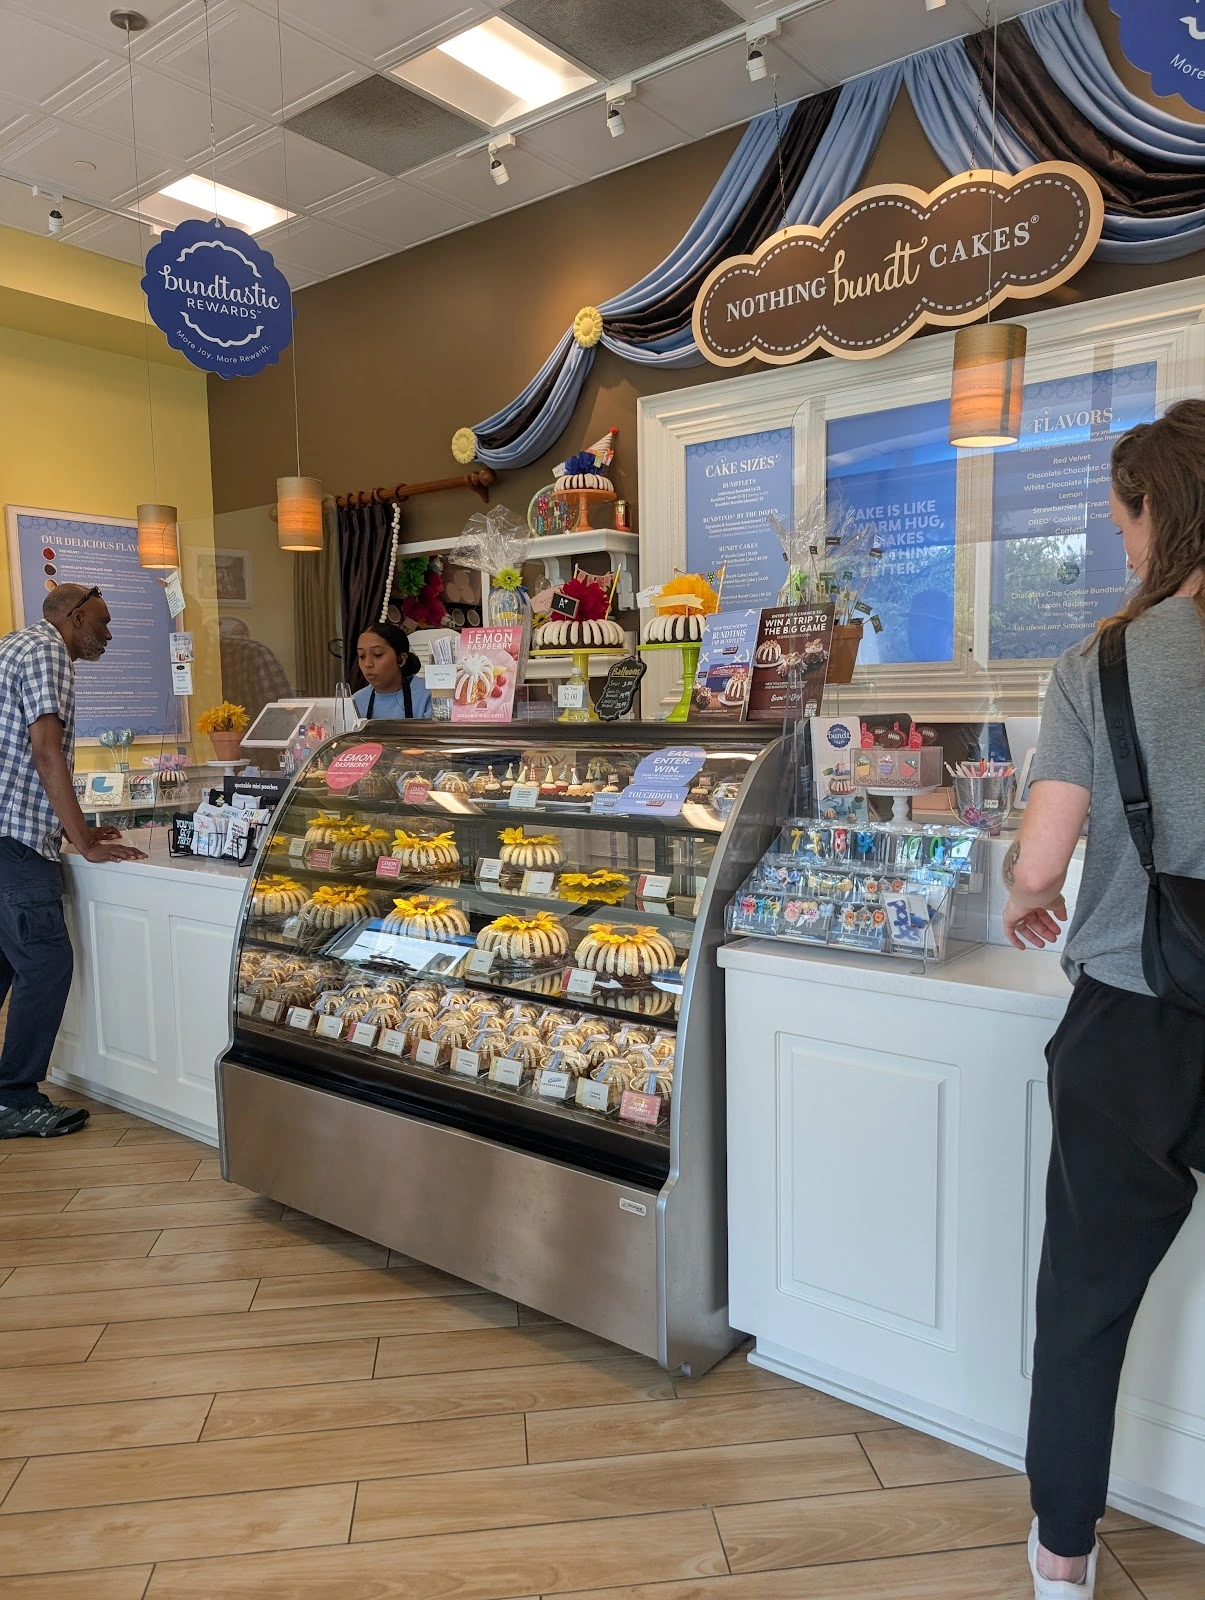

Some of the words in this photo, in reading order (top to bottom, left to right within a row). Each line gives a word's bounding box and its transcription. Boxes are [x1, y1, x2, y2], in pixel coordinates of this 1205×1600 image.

[726, 277, 827, 322] NOTHING
[828, 236, 928, 306] bundt
[158, 265, 281, 310] bundtastic
[176, 330, 196, 349] More
[197, 348, 213, 360] Joy.
[216, 353, 238, 364] More
[240, 345, 271, 363] Rewards.
[1031, 407, 1113, 434] FLAVORS
[1053, 457, 1067, 465] Red
[1068, 453, 1091, 462] Velvet
[705, 461, 738, 478] CAKE
[740, 455, 778, 474] SIZES
[1027, 470, 1062, 479] Chocolate
[1063, 464, 1100, 474] Chocolate
[1023, 483, 1045, 491] White
[1046, 479, 1082, 488] Chocolate
[1058, 491, 1083, 499] Lemon
[848, 505, 884, 521] AKE
[888, 504, 900, 517] IS
[903, 500, 936, 515] LIKE
[1032, 504, 1077, 514] Strawberries
[1086, 499, 1110, 508] Cream
[745, 510, 758, 518] THE
[1052, 515, 1081, 524] Cookies
[905, 514, 945, 530] HUG,
[1055, 525, 1085, 534] Confetti
[42, 535, 63, 546] OUR
[65, 537, 115, 551] DELICIOUS
[880, 531, 925, 547] AKES
[739, 542, 758, 550] CAKES
[1011, 590, 1045, 600] Chocolate
[1046, 589, 1063, 598] Chip
[1064, 587, 1089, 596] Cookie
[1037, 600, 1061, 609] Lemon
[1062, 599, 1099, 609] Raspberry
[765, 618, 784, 627] WIN
[785, 617, 792, 626] A
[793, 616, 813, 625] TRIP
[816, 614, 827, 623] TO
[1026, 623, 1048, 631] about
[1062, 620, 1096, 630] Seasonal
[712, 630, 747, 640] BUNDTINIS
[764, 627, 780, 636] THE
[783, 625, 797, 634] BIG
[800, 623, 826, 633] GAME
[468, 633, 513, 644] LEMON
[467, 642, 513, 651] RASPBERRY
[828, 730, 851, 739] bundt
[338, 753, 377, 762] LEMON
[653, 757, 691, 765] ENTER.
[654, 765, 680, 774] WIN.
[235, 782, 252, 790] quotable
[628, 792, 681, 800] TOUCHDOWN
[243, 809, 259, 818] FIND
[180, 828, 191, 837] GOT
